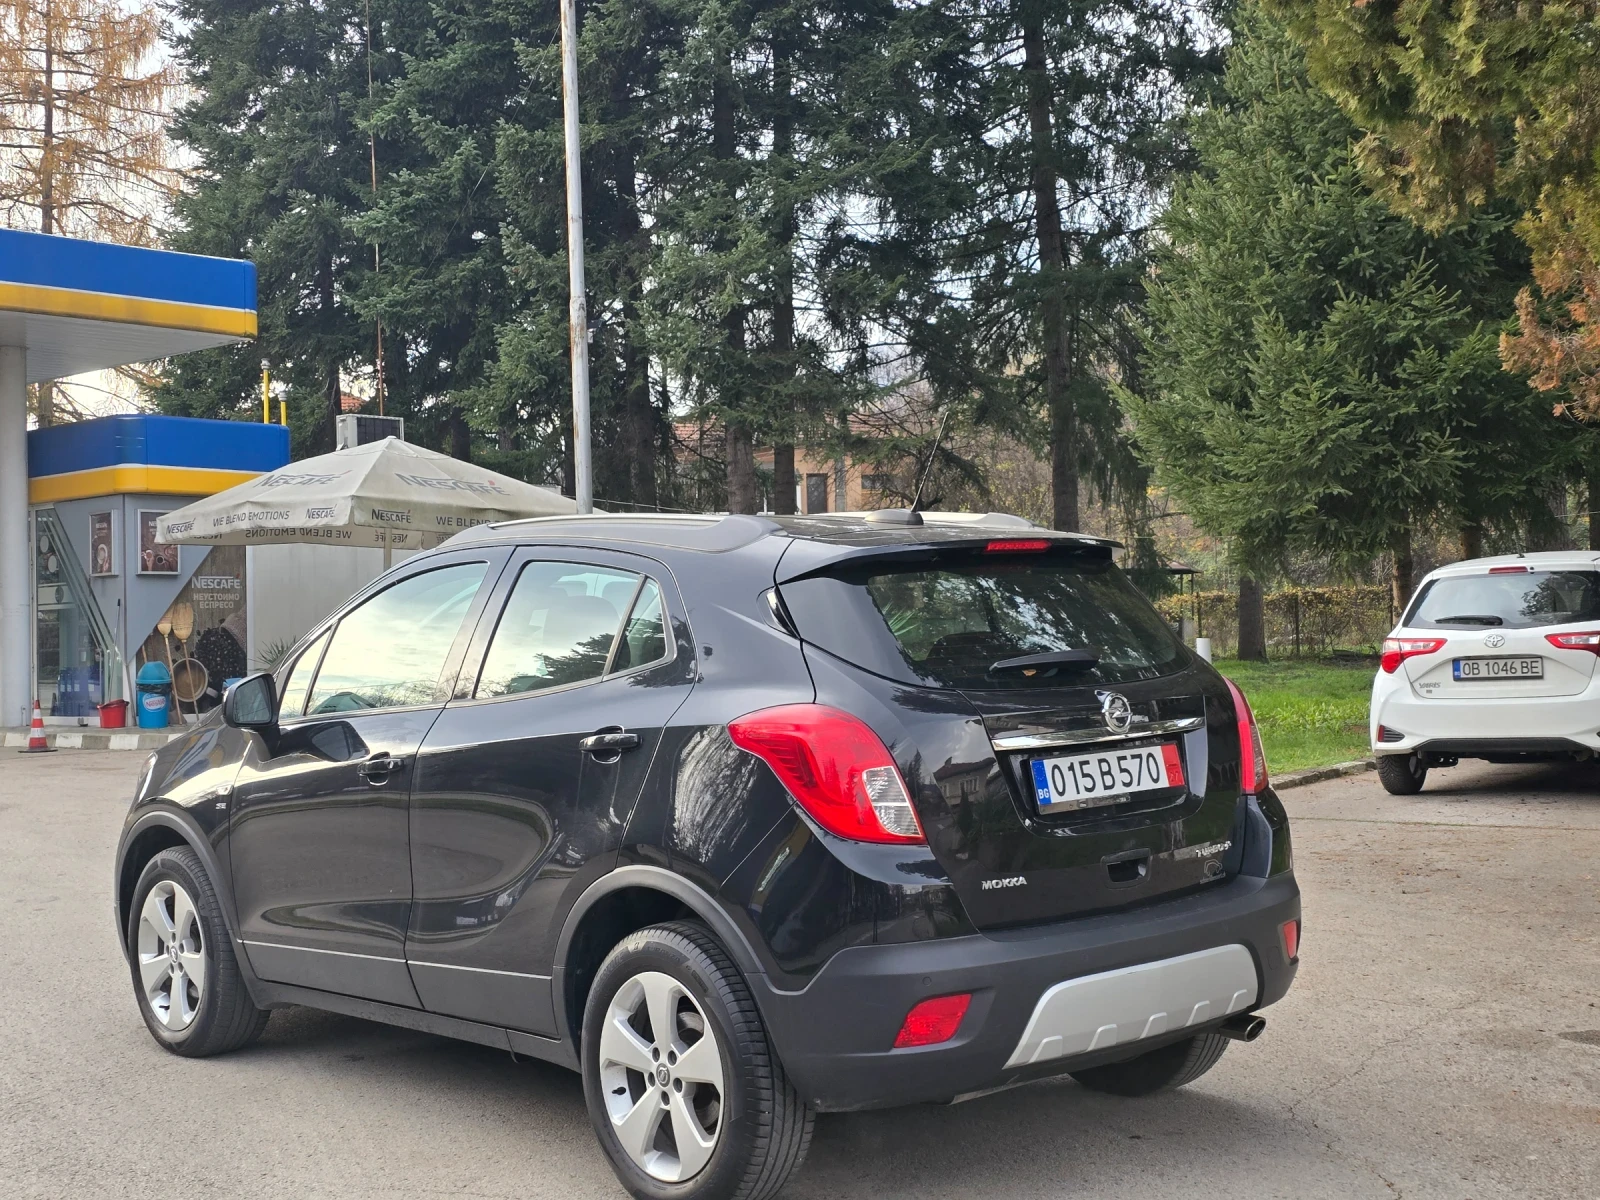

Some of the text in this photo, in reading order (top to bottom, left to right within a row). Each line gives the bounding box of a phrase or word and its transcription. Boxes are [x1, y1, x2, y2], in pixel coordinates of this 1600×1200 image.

[212, 511, 291, 528] WE BLEND EMOTIONS
[436, 515, 453, 526] WE
[193, 593, 240, 601] НЕУСТОИМО
[199, 601, 234, 609] ЕСПРЕСО
[1484, 661, 1518, 676] 1046
[1520, 660, 1540, 674] BE
[1038, 789, 1050, 800] BG
[981, 876, 1028, 890] MOKKA
